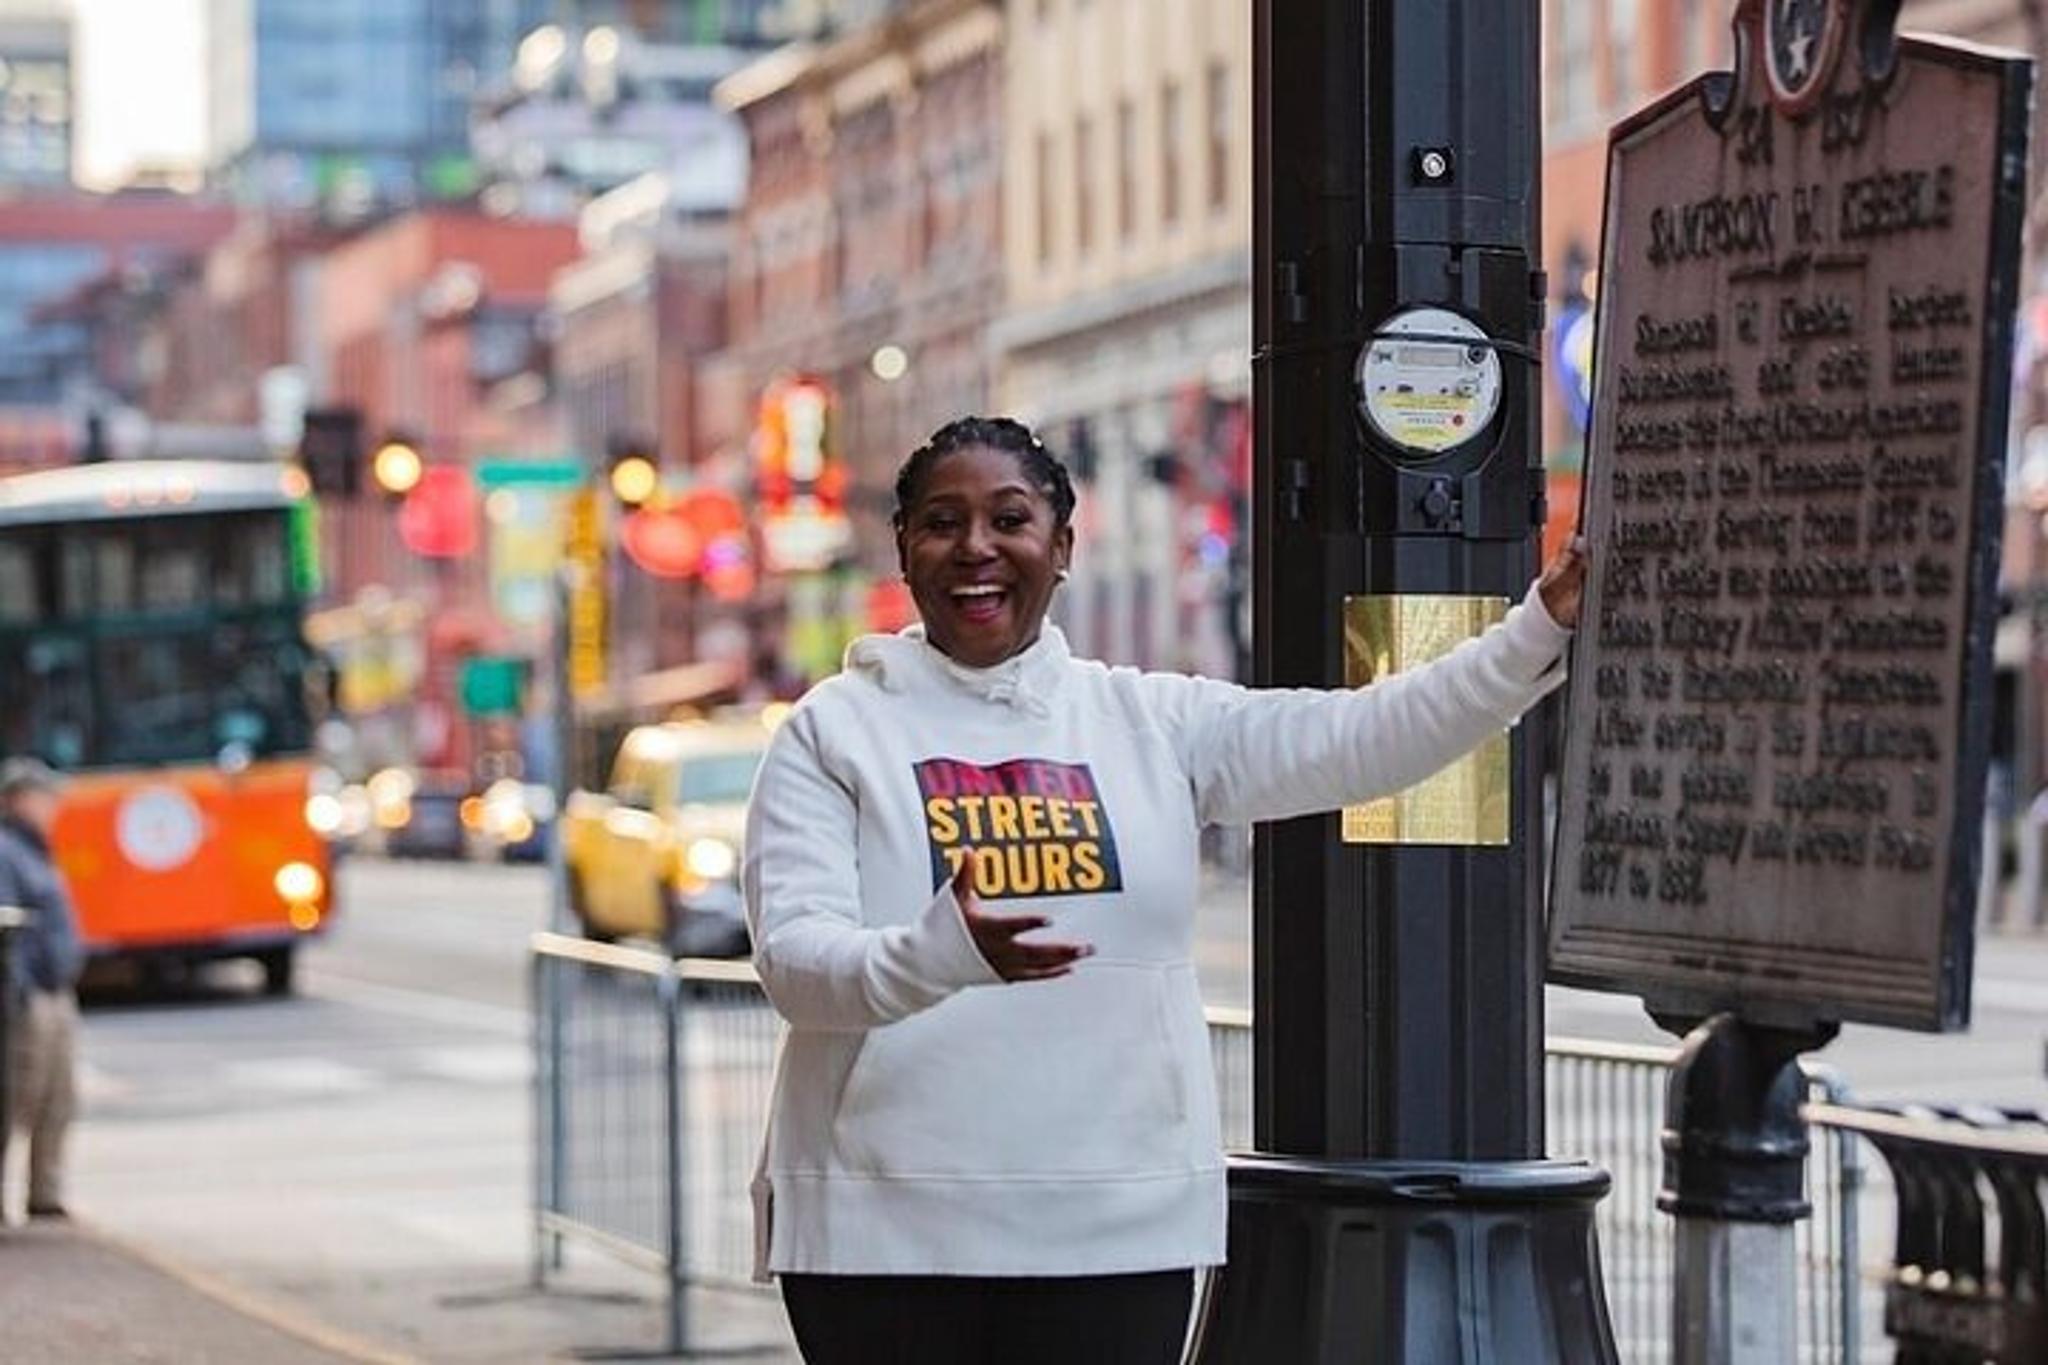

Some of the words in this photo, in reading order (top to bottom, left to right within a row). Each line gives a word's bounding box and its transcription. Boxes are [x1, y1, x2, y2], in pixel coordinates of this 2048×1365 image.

[1647, 194, 1775, 267] SAMPSON
[1794, 184, 1820, 245] W.
[1841, 166, 1954, 241] KEEBLE
[1634, 308, 1718, 355] Sampson
[1757, 353, 1797, 395] and
[1615, 411, 1683, 453] became
[1687, 409, 1717, 449] the
[1612, 470, 1628, 500] to
[1718, 460, 1751, 494] the
[1758, 450, 1864, 492] Tennessee
[1869, 442, 1958, 489] General
[1714, 505, 1796, 556] Serving
[1802, 501, 1859, 545] from
[1928, 500, 1955, 541] to
[1727, 567, 1760, 597] was
[1881, 556, 1907, 595] to
[1914, 555, 1952, 595] the
[1596, 665, 1627, 698] and
[1639, 664, 1672, 699] the
[923, 763, 1092, 800] UNITED
[926, 795, 1100, 842] STREET
[1628, 861, 1651, 902] to
